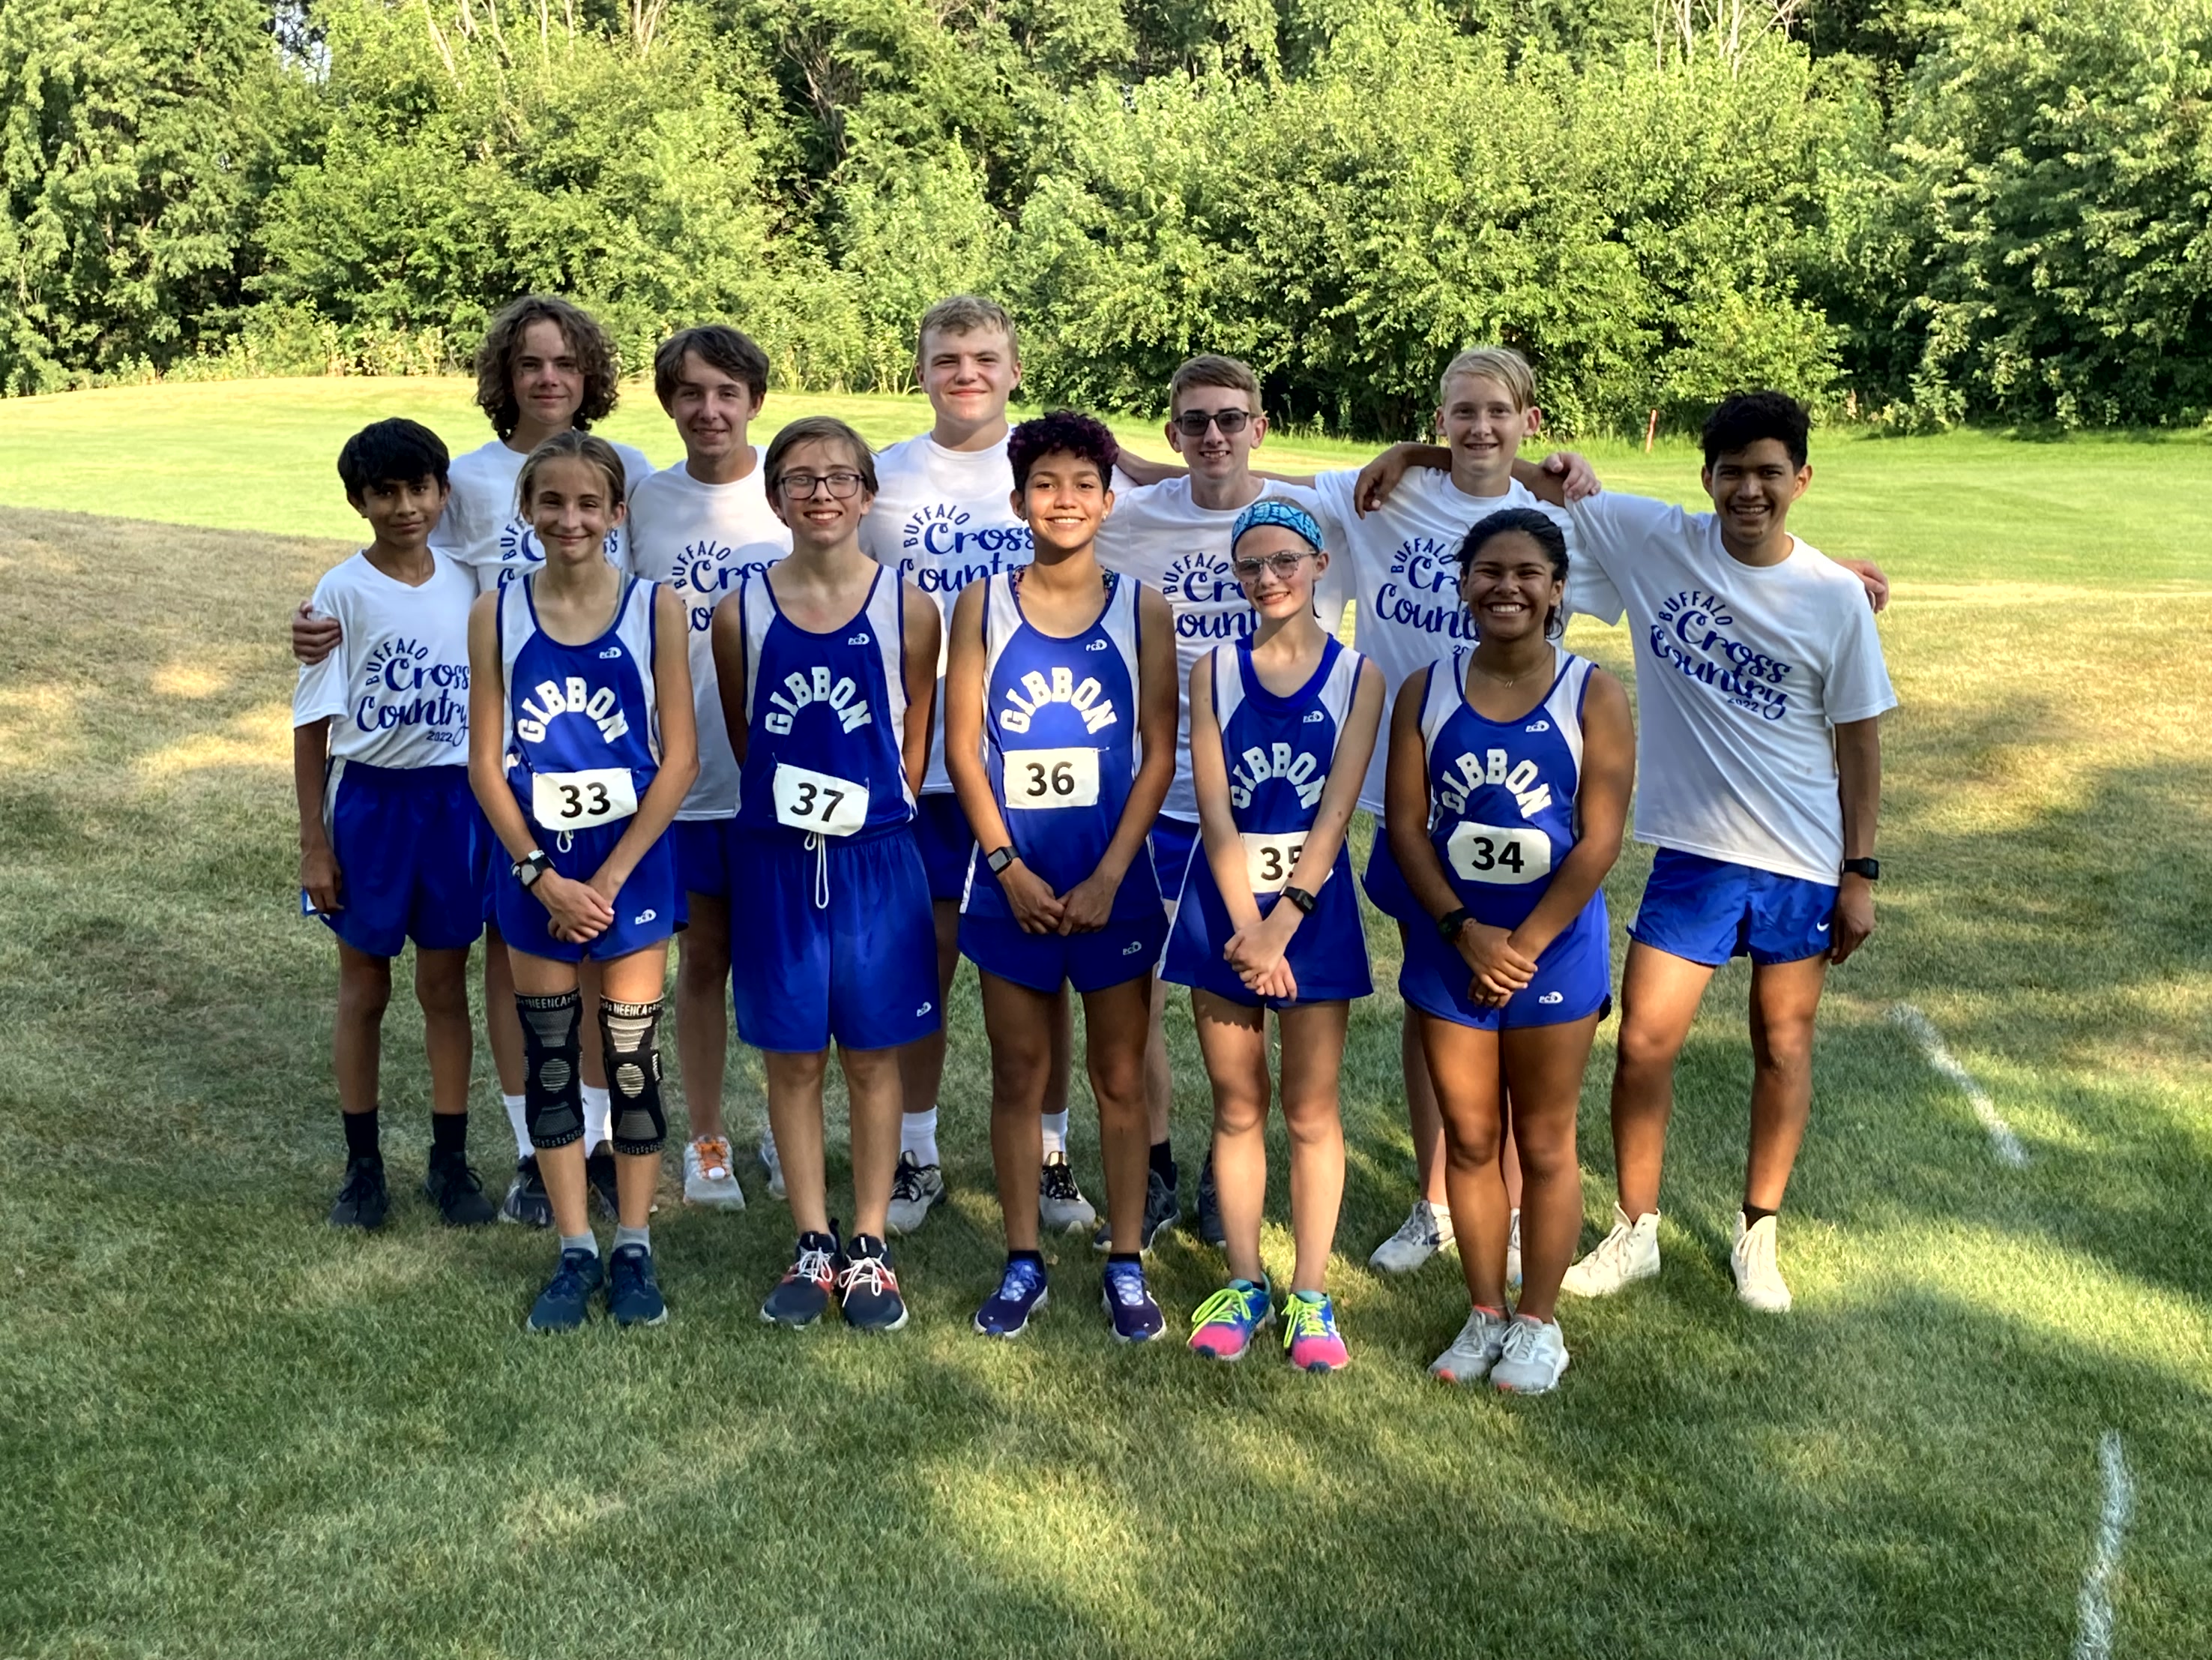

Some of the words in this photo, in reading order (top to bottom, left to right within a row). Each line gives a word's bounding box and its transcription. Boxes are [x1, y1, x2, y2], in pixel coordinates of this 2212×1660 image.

[500, 516, 525, 561] BUFF
[903, 504, 970, 548] BUFFALO
[672, 541, 731, 589] BUFFALO
[1163, 553, 1229, 595] BUFFALO
[1390, 538, 1456, 574] BUFFALO
[1175, 606, 1259, 639] ount
[1376, 583, 1480, 642] Count
[1658, 591, 1733, 625] BUFFALO
[366, 638, 428, 686] BUFFALO
[1676, 610, 1792, 683] Cross
[385, 658, 469, 691] Cross
[1651, 625, 1788, 721] Country
[357, 688, 469, 747] Country
[517, 676, 629, 744] GIBBON
[765, 667, 872, 735] GIBBON
[1000, 667, 1118, 735] GIBBON
[426, 730, 453, 742] 2022
[1026, 762, 1075, 796] 36
[1230, 742, 1326, 810] GIBBON
[1441, 748, 1552, 819] GIBBON
[559, 782, 611, 819] 33
[789, 782, 845, 823] 37
[1471, 837, 1525, 873] 34
